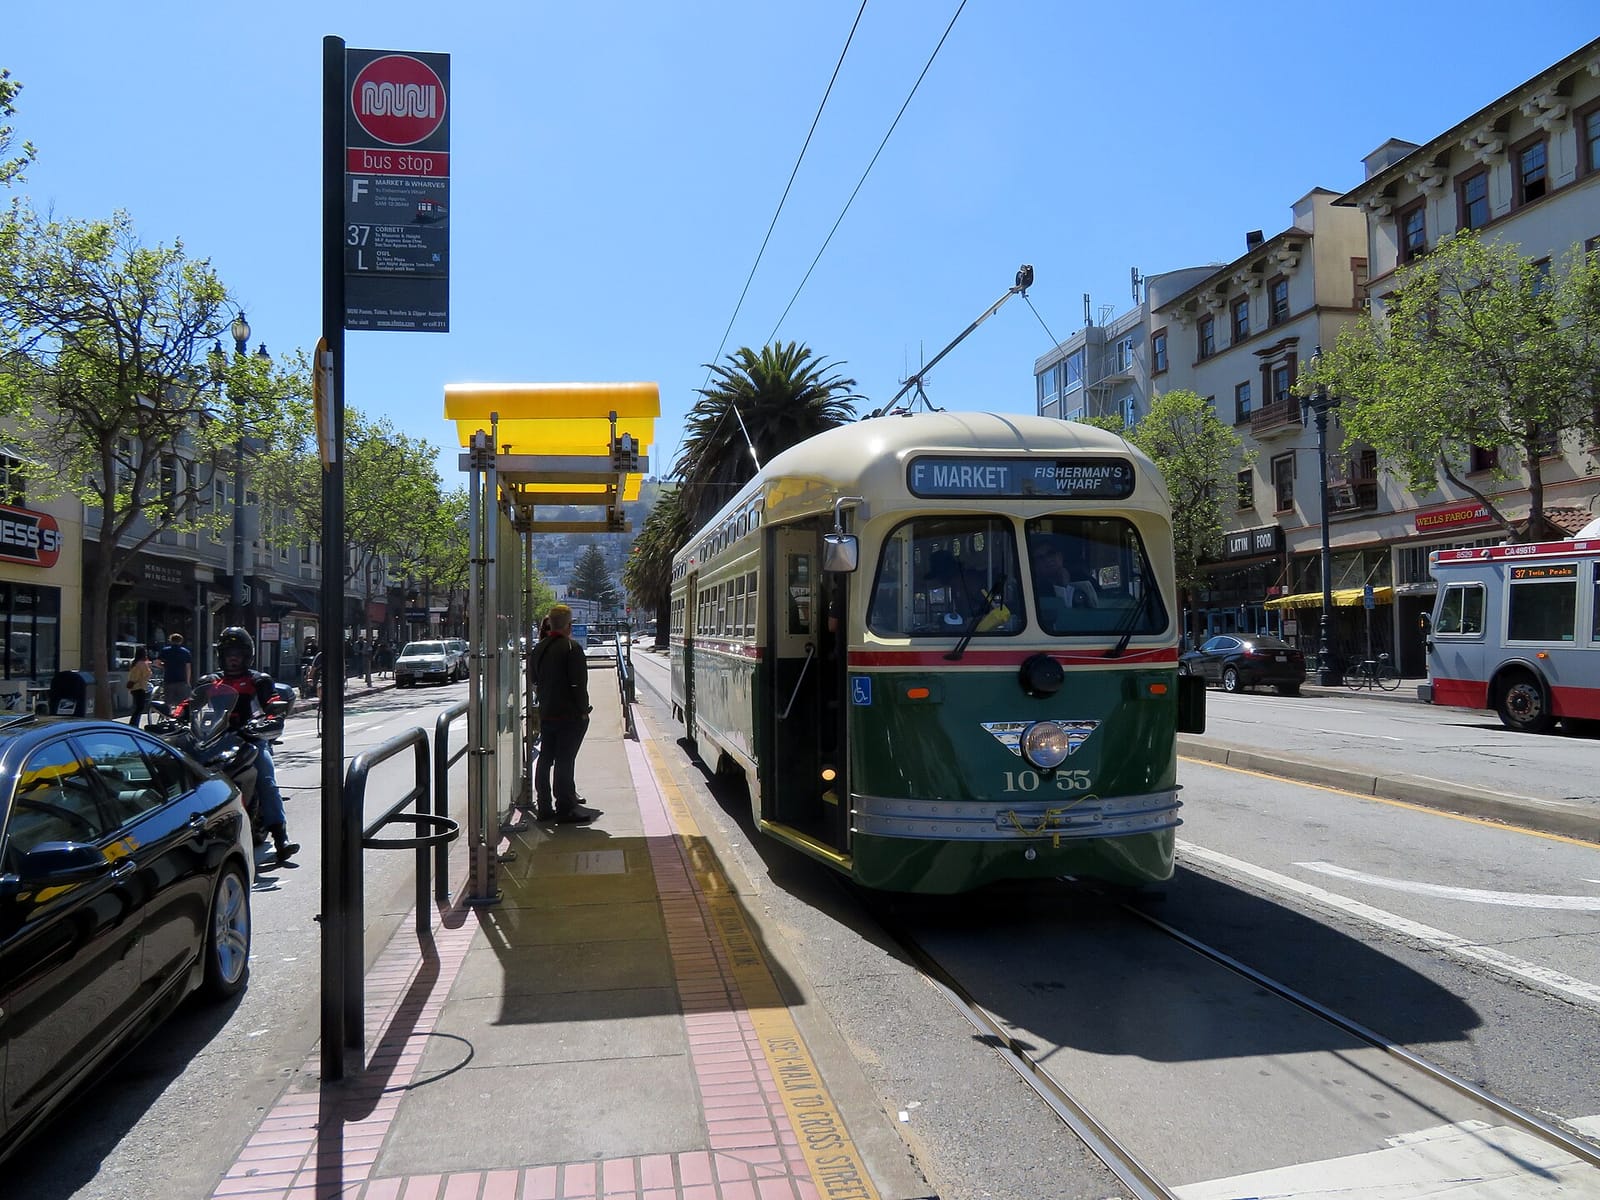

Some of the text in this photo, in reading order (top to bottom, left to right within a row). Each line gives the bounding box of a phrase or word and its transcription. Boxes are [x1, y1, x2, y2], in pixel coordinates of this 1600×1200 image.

[363, 150, 433, 175] bus stop
[352, 179, 369, 203] F
[411, 181, 445, 189] WHARVES
[347, 225, 371, 246] 37
[358, 249, 369, 270] L
[914, 465, 1008, 488] F MARKET
[1034, 466, 1122, 479] FISHERMAN'S
[1055, 478, 1102, 490] WHARF
[1416, 508, 1489, 527] WELLS FARGO ATM
[0, 519, 39, 549] ESS
[1230, 533, 1272, 553] LATIN FOOD
[1515, 569, 1526, 578] 37
[775, 1055, 817, 1092] X-WALK
[789, 1093, 825, 1108] TO
[797, 1110, 845, 1151] CROSS
[816, 1154, 870, 1200] STREET
